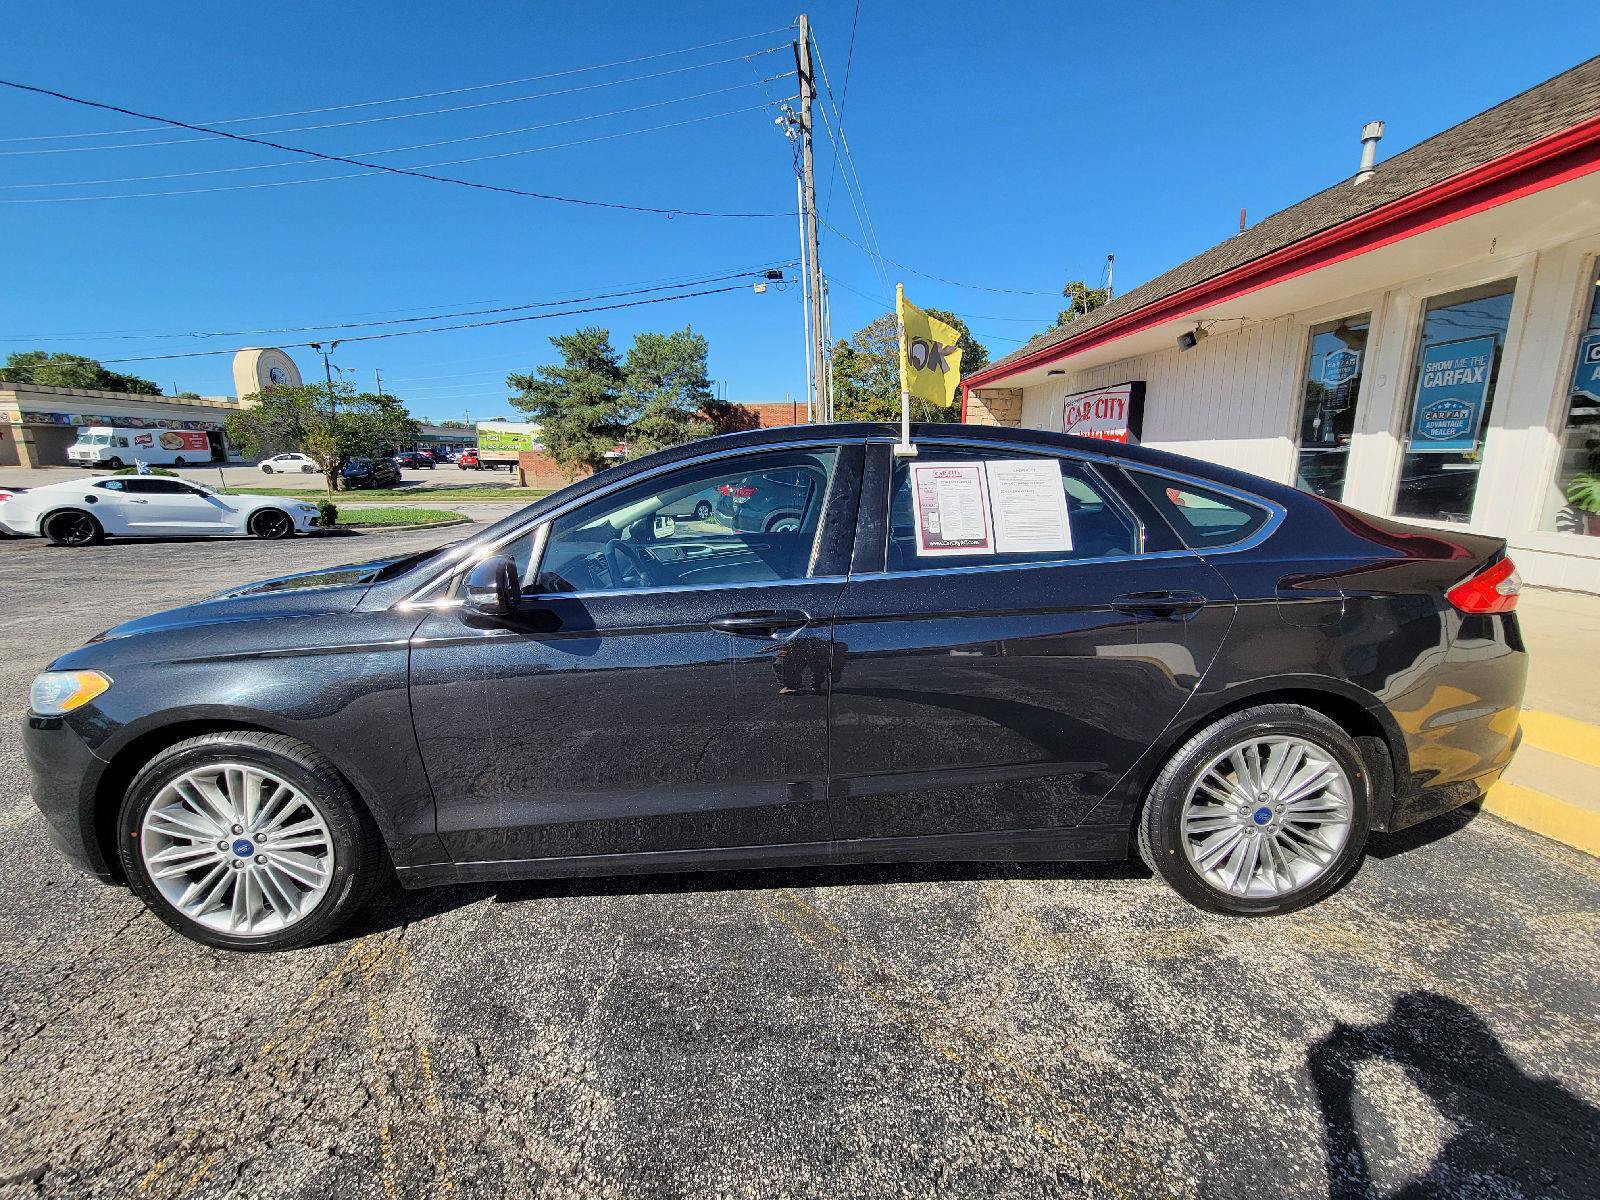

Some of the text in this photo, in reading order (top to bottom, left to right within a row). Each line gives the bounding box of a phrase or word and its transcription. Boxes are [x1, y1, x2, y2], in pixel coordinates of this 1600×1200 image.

[1425, 355, 1487, 373] SHOW ME THE
[1424, 367, 1487, 388] CARFAX
[1066, 398, 1126, 426] CAR CITY
[1425, 410, 1469, 420] CARFAX
[1425, 420, 1463, 429] ADVANTAGE
[1430, 428, 1456, 436] DEALER
